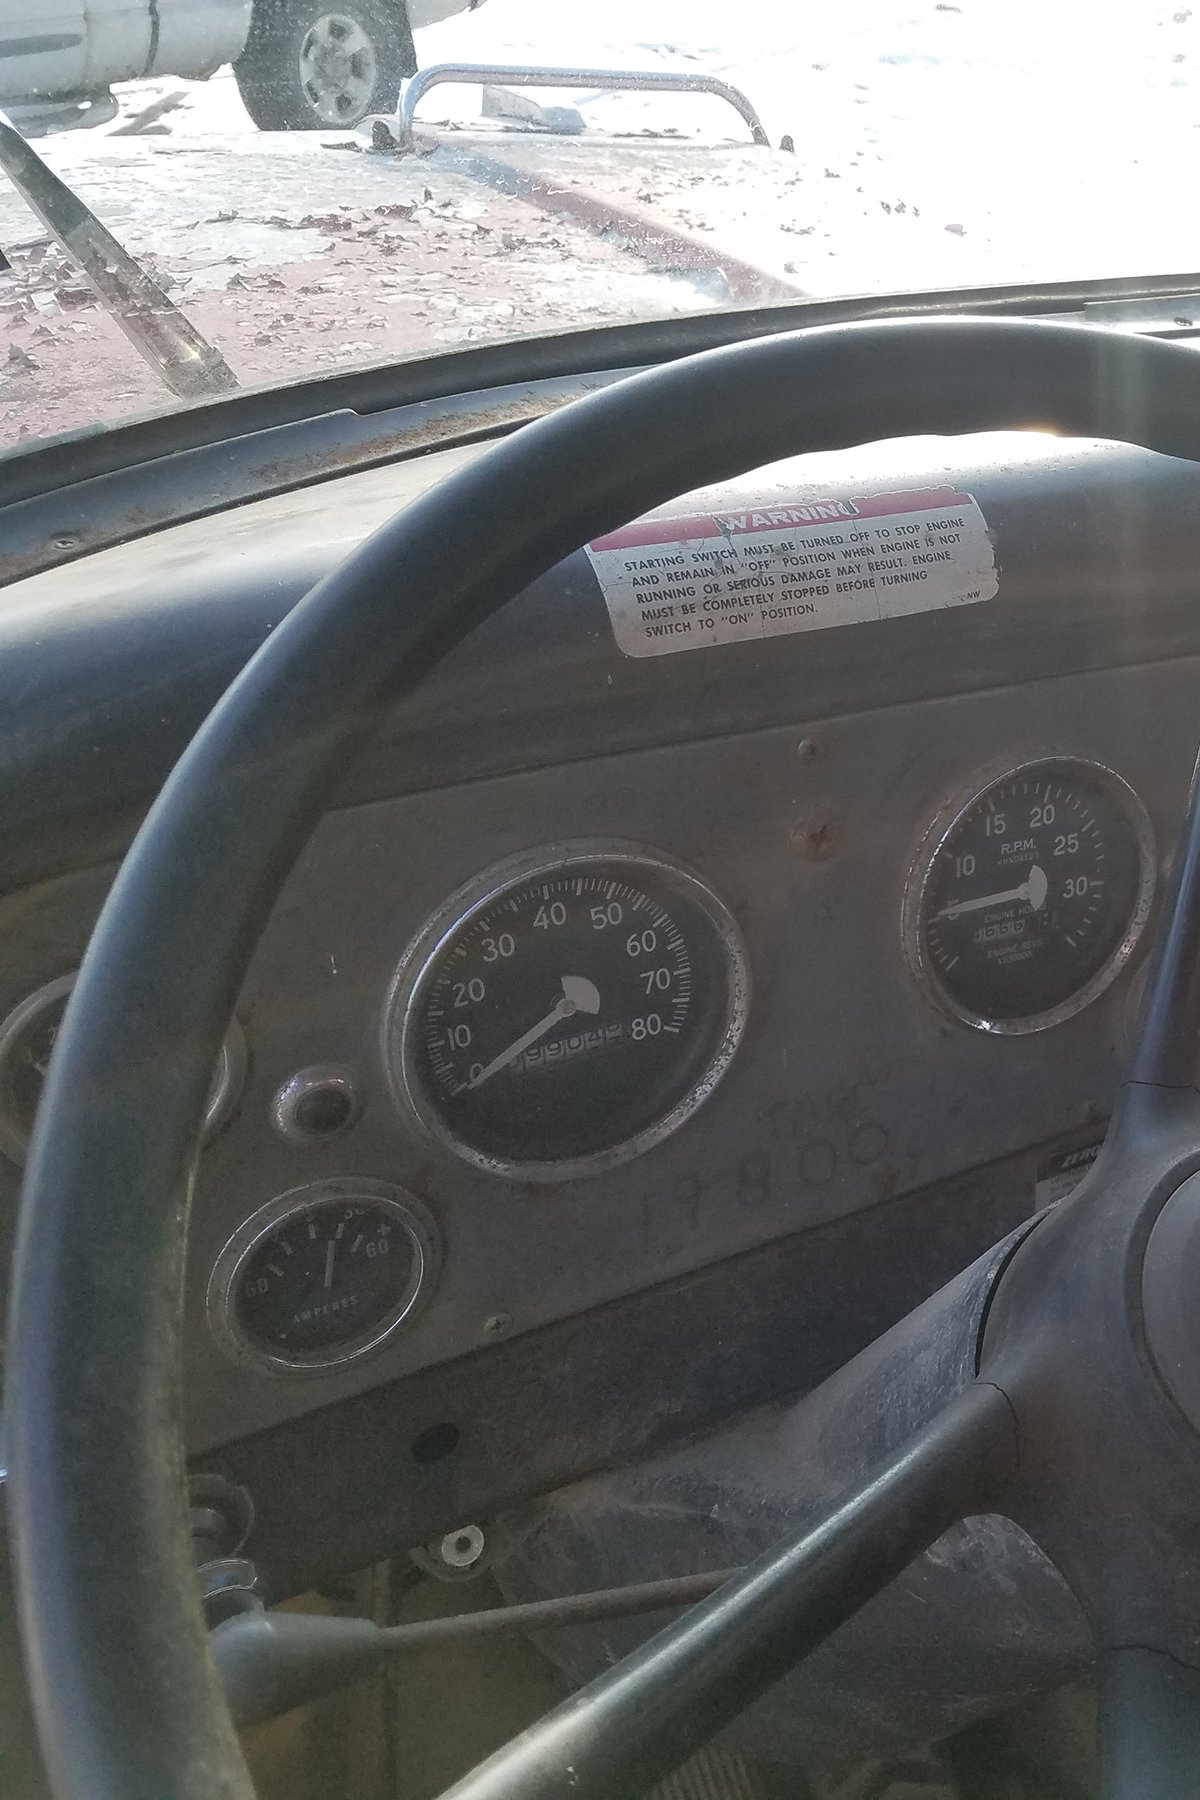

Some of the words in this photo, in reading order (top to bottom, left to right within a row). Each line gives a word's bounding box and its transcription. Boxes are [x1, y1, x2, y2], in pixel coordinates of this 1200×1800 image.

[624, 555, 685, 571] STARTING
[692, 548, 737, 563] SWITCH
[744, 543, 774, 557] MUST
[781, 541, 796, 551] BE
[800, 535, 843, 549] TURNED
[850, 532, 870, 542] OFF
[874, 528, 890, 539] TO
[895, 525, 921, 536] STOP
[926, 518, 965, 532] ENGINE
[632, 575, 660, 587] AND
[666, 567, 714, 583] REMAIN
[722, 565, 735, 576] IN
[783, 551, 836, 567] POSITION
[841, 546, 875, 559] WHEN
[880, 539, 921, 554] ENGINE
[925, 537, 934, 547] IS
[940, 534, 961, 545] NOT
[636, 586, 696, 604] RUNNING
[703, 583, 722, 595] OR
[727, 576, 775, 592] SERIOUS
[781, 568, 831, 584] DAMAGE
[837, 564, 862, 577] MAY
[868, 558, 907, 572] RESULT.
[912, 550, 951, 564] ENGINE
[641, 607, 674, 621] MUST
[682, 603, 696, 614] BE
[703, 592, 774, 612] COMPLETELY
[781, 585, 829, 601] STOPPED
[836, 578, 875, 593] BEFORE
[880, 570, 928, 587] TURNING
[645, 622, 691, 638] SWITCH
[698, 618, 715, 630] TO
[762, 604, 818, 620] POSITION.
[985, 813, 1007, 837] 15
[1029, 804, 1056, 829] 20
[1053, 832, 1080, 856] 25
[956, 855, 976, 878] 10
[1063, 876, 1088, 899] 30
[533, 902, 567, 930] 40
[590, 902, 623, 930] 50
[481, 933, 515, 962] 30
[626, 930, 657, 957] 60
[452, 978, 486, 1008] 20
[640, 968, 671, 994] 70
[448, 1024, 472, 1050] 10
[631, 1014, 662, 1040] 80
[366, 1239, 389, 1259] 60
